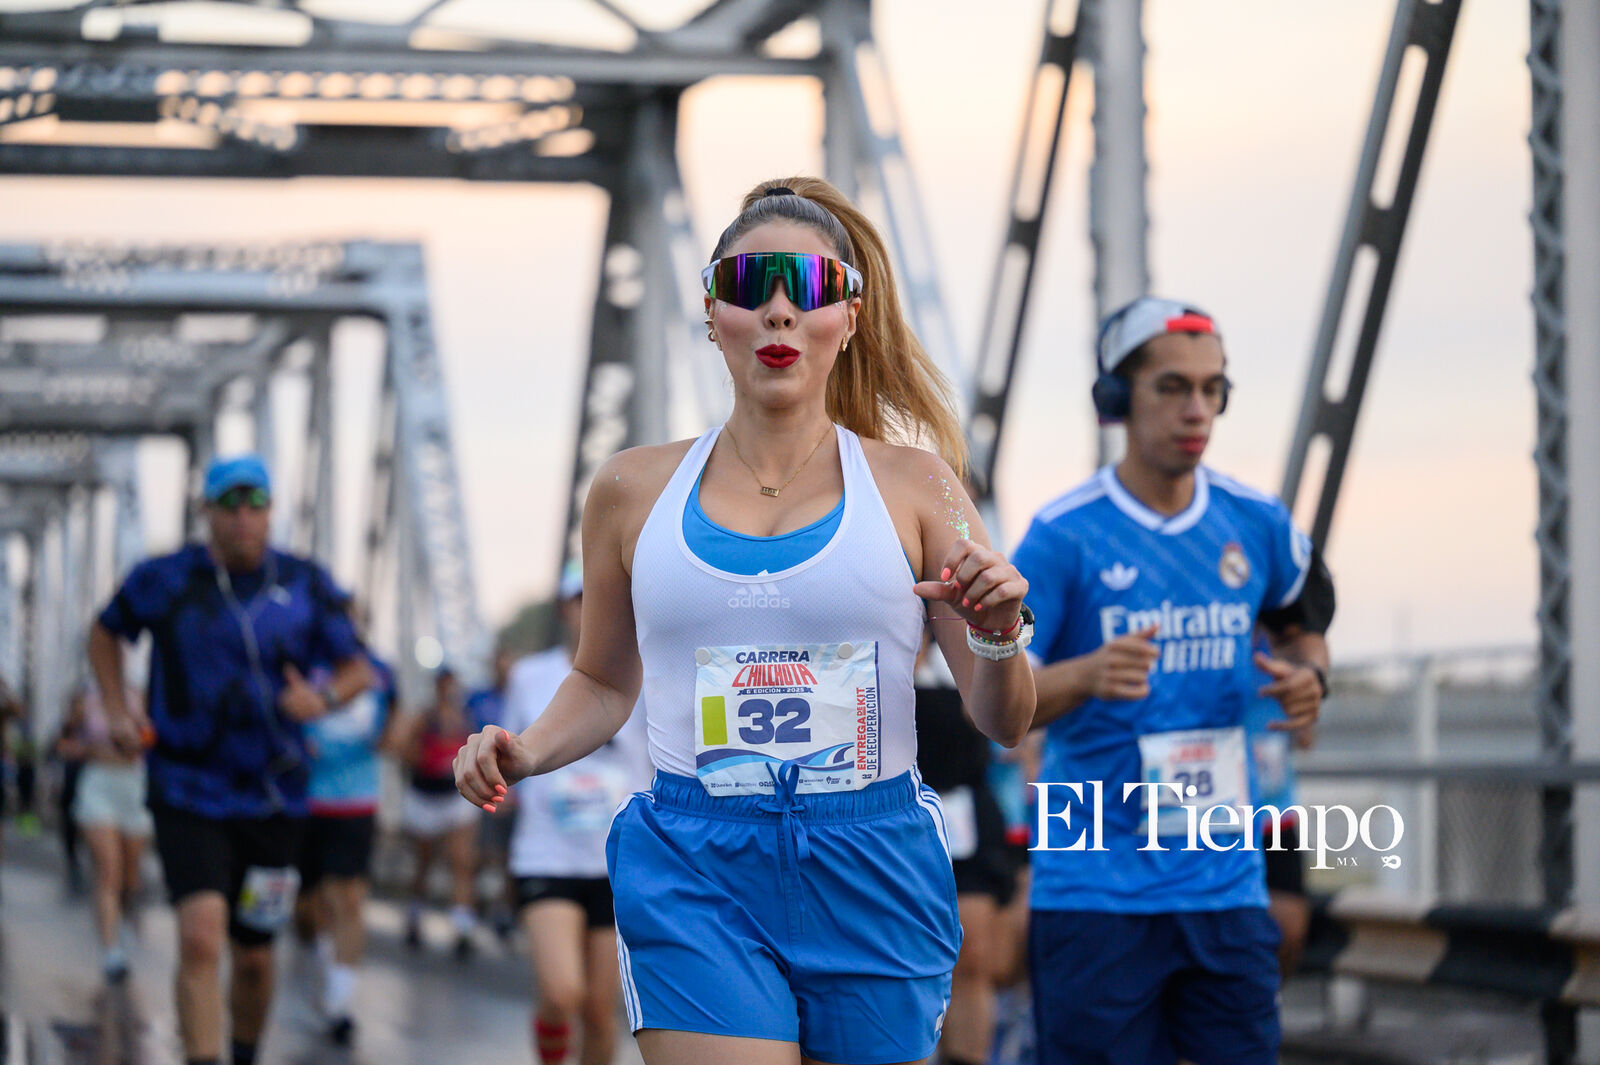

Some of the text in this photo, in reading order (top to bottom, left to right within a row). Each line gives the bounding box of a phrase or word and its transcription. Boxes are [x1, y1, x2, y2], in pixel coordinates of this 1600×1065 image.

[727, 594, 791, 609] adidas
[1100, 600, 1252, 645] Emirates
[735, 650, 810, 664] CARRERA
[1162, 637, 1236, 674] BETTER
[732, 664, 818, 687] CHILCHOTA
[856, 687, 866, 706] KIT
[737, 697, 812, 745] 32
[865, 687, 877, 770] DE RECUPERACIÓN
[857, 716, 867, 770] ENTREGA
